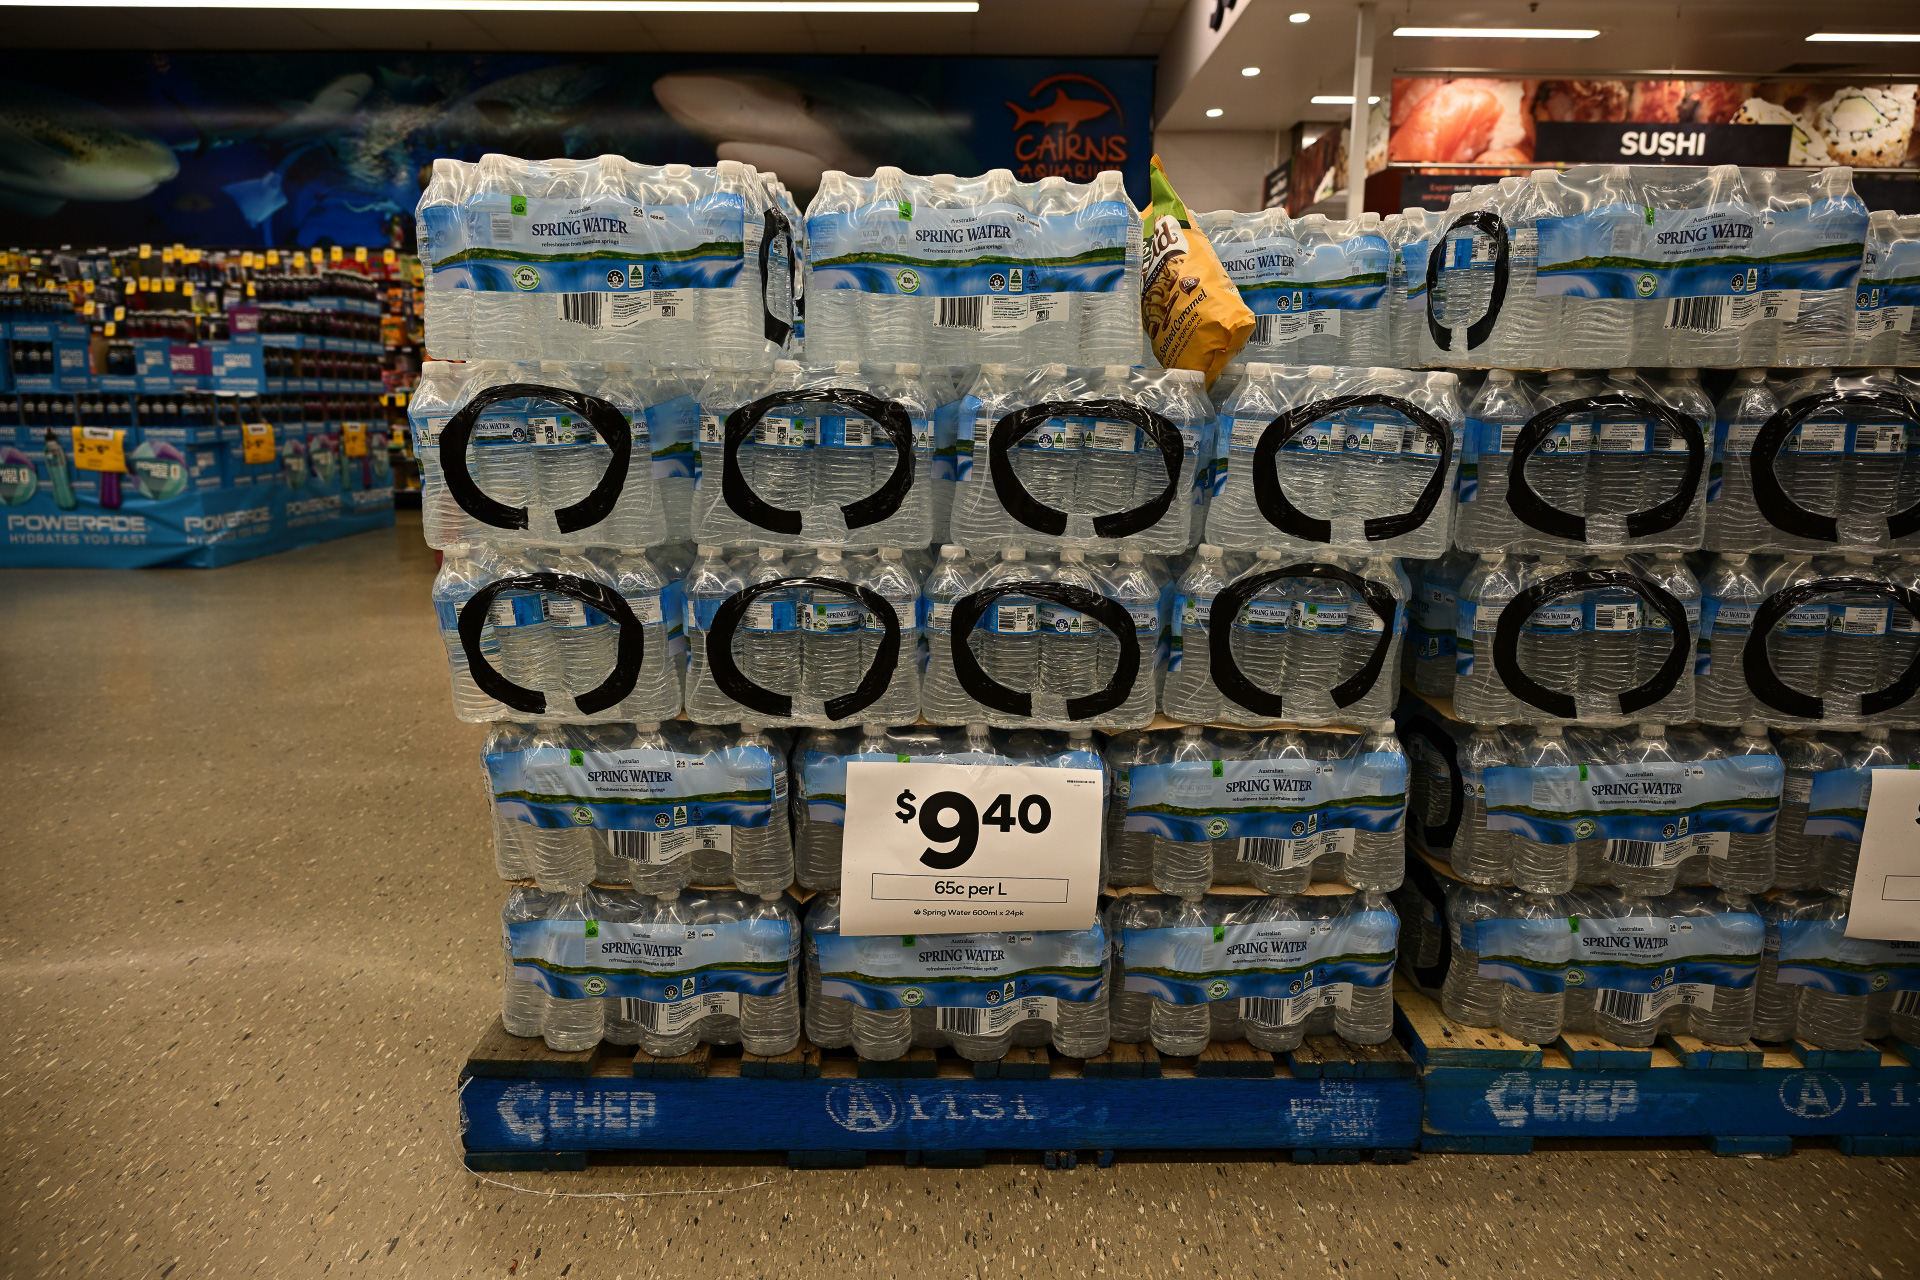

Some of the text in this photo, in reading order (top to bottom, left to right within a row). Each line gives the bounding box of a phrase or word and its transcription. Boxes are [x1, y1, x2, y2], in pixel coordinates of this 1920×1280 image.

[1620, 131, 1706, 157] SUSHI
[633, 206, 643, 215] 24
[1692, 212, 1726, 224] Australian
[532, 217, 628, 237] SPRING WATER
[916, 224, 1011, 243] SPRING WATER
[1657, 224, 1754, 246] SPRING WATER
[602, 238, 619, 247] springs
[986, 244, 1002, 252] springs
[1258, 253, 1295, 269] WATER
[1141, 259, 1166, 294] CHOCOLATE
[1158, 325, 1178, 358] Salted
[1172, 288, 1208, 331] Caramel
[1187, 317, 1204, 340] CHOCOLATE
[1165, 341, 1181, 367] NATURAL
[1177, 311, 1200, 343] POPCORN
[489, 422, 511, 430] WATER
[136, 461, 162, 472] POWER
[150, 470, 169, 478] ADE
[7, 514, 146, 534] POWERADE
[184, 506, 269, 532] POWERADE
[9, 534, 147, 546] HYDRATES YOU FAST
[1433, 591, 1442, 599] 24
[826, 611, 846, 619] SPRING
[1316, 612, 1336, 620] SPRING
[1551, 612, 1571, 620] WATER
[1729, 611, 1751, 619] WATER
[588, 768, 673, 784] SPRING WATER
[649, 786, 666, 794] springs
[1226, 778, 1312, 794] SPRING WATER
[1591, 781, 1683, 797] SPRING WATER
[934, 880, 1008, 900] 65c per L
[922, 908, 946, 918] Spring
[947, 908, 972, 917] Water
[972, 908, 998, 917] 600ml
[1004, 909, 1024, 918] 24pk
[602, 941, 682, 958] SPRING WATER
[1226, 940, 1308, 957] SPRING WATER
[1582, 936, 1669, 950] SPRING WATER
[918, 948, 1005, 963] SPRING WATER
[660, 961, 676, 969] springs
[1533, 1079, 1639, 1122] CHEP
[1798, 1072, 1920, 1114] A 11
[549, 1091, 656, 1128] CHEP
[848, 1082, 1040, 1132] A 1131
